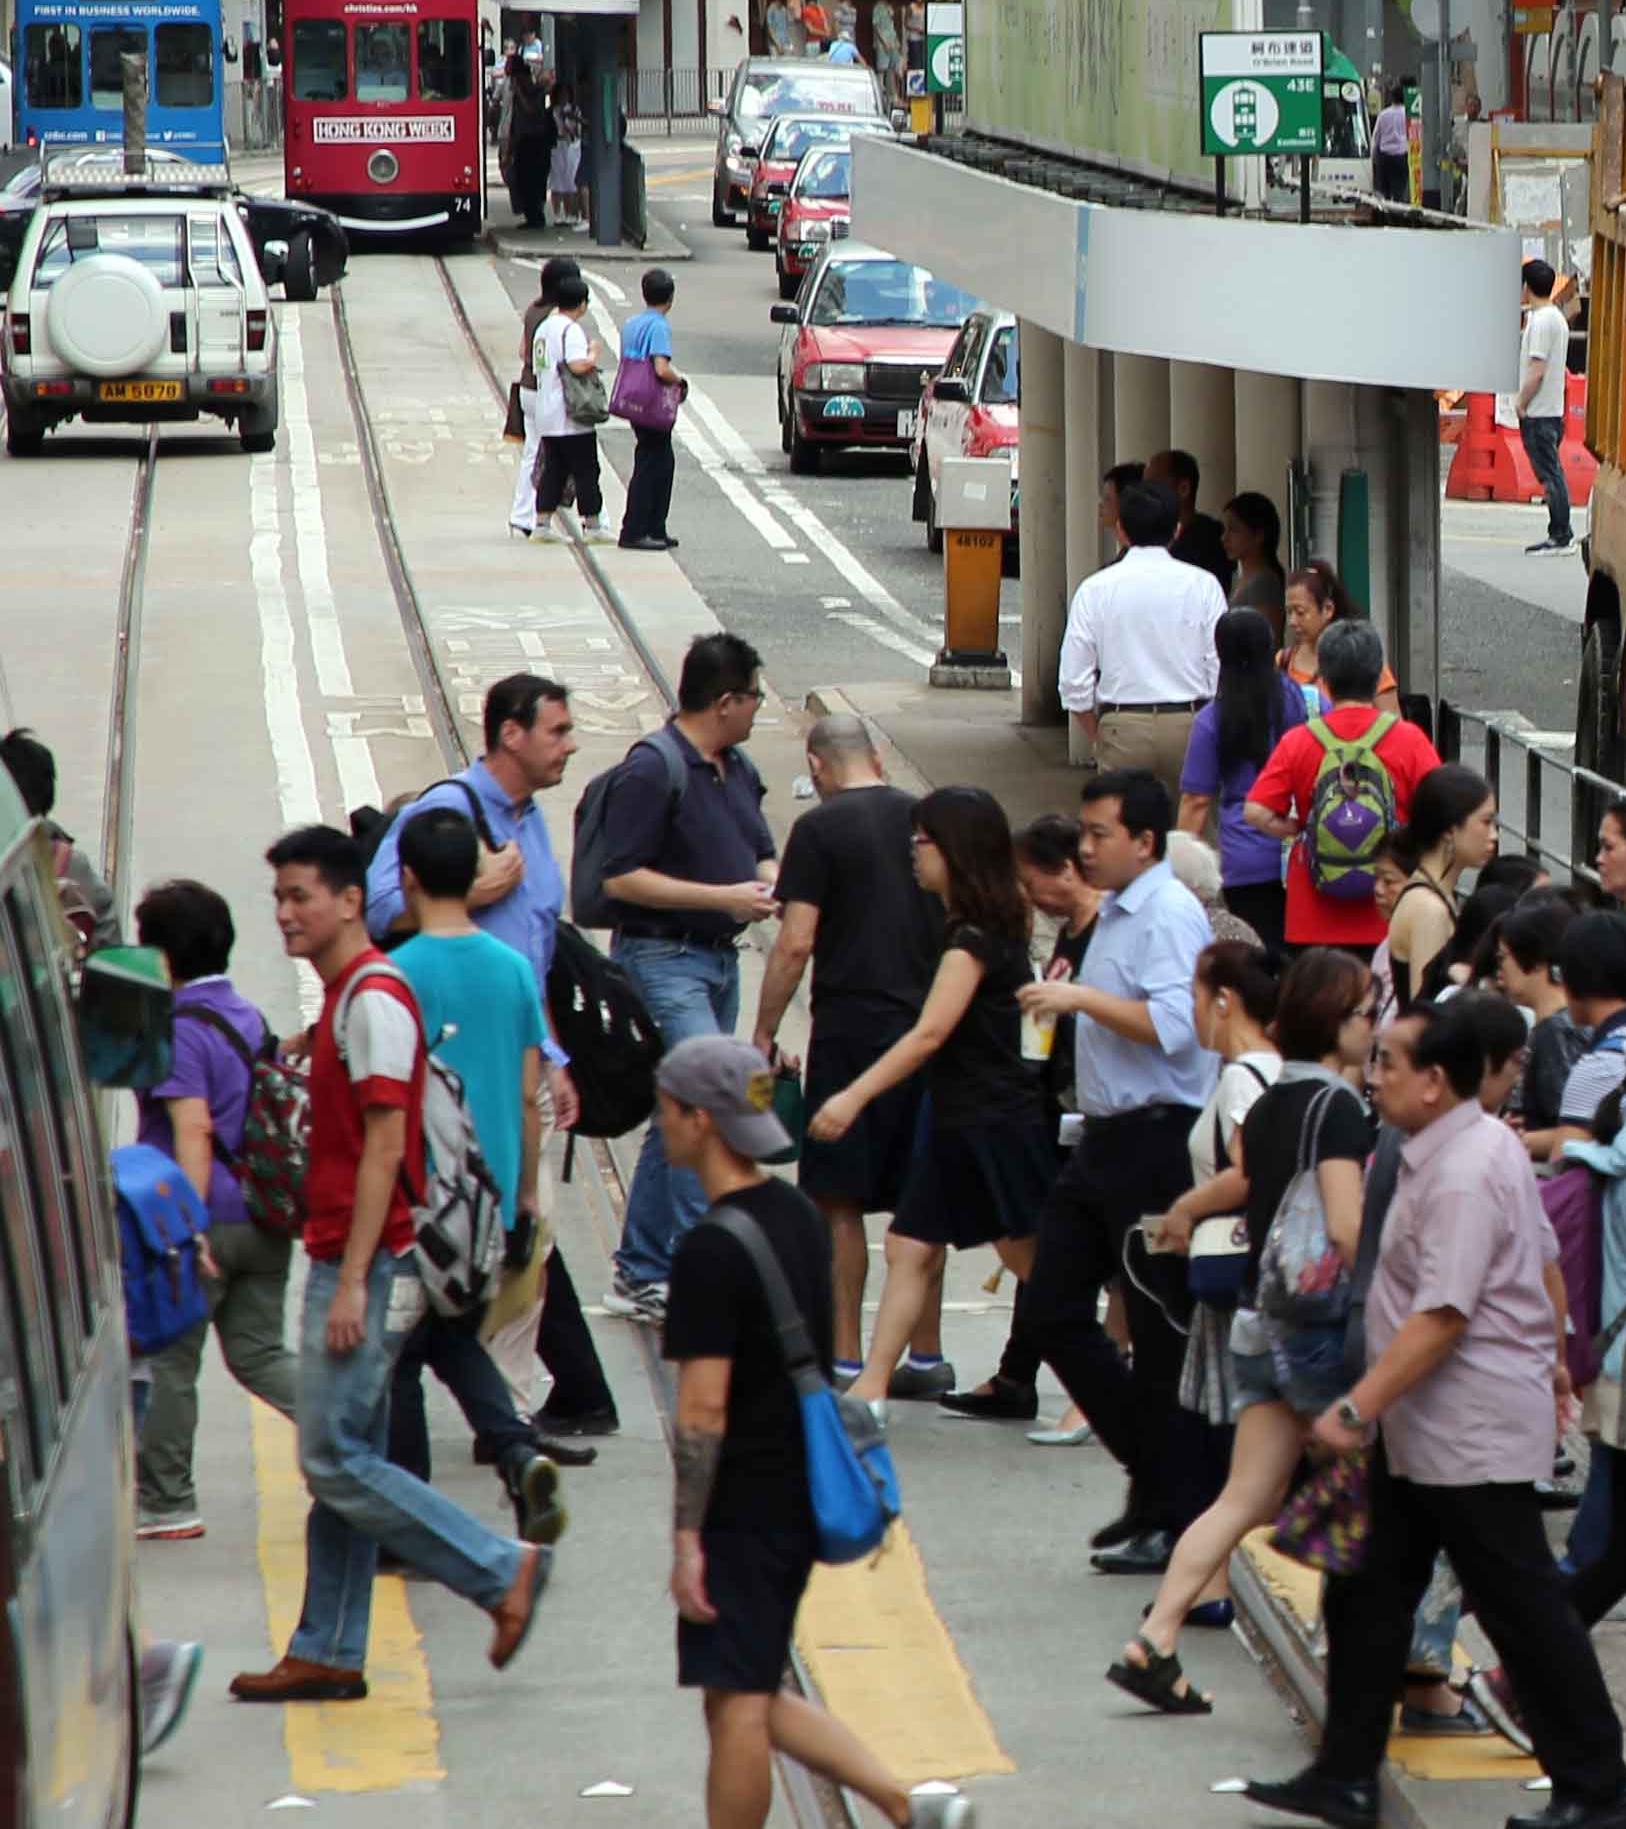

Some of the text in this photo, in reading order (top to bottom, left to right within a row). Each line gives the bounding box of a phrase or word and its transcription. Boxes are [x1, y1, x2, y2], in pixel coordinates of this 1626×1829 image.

[34, 5, 62, 16] FIRST
[64, 5, 76, 16] IN
[79, 5, 130, 16] BUSINESS
[1287, 78, 1315, 92] 43E
[317, 119, 451, 139] HONG KONG WEEK
[454, 196, 472, 213] 74
[104, 385, 126, 399] AM
